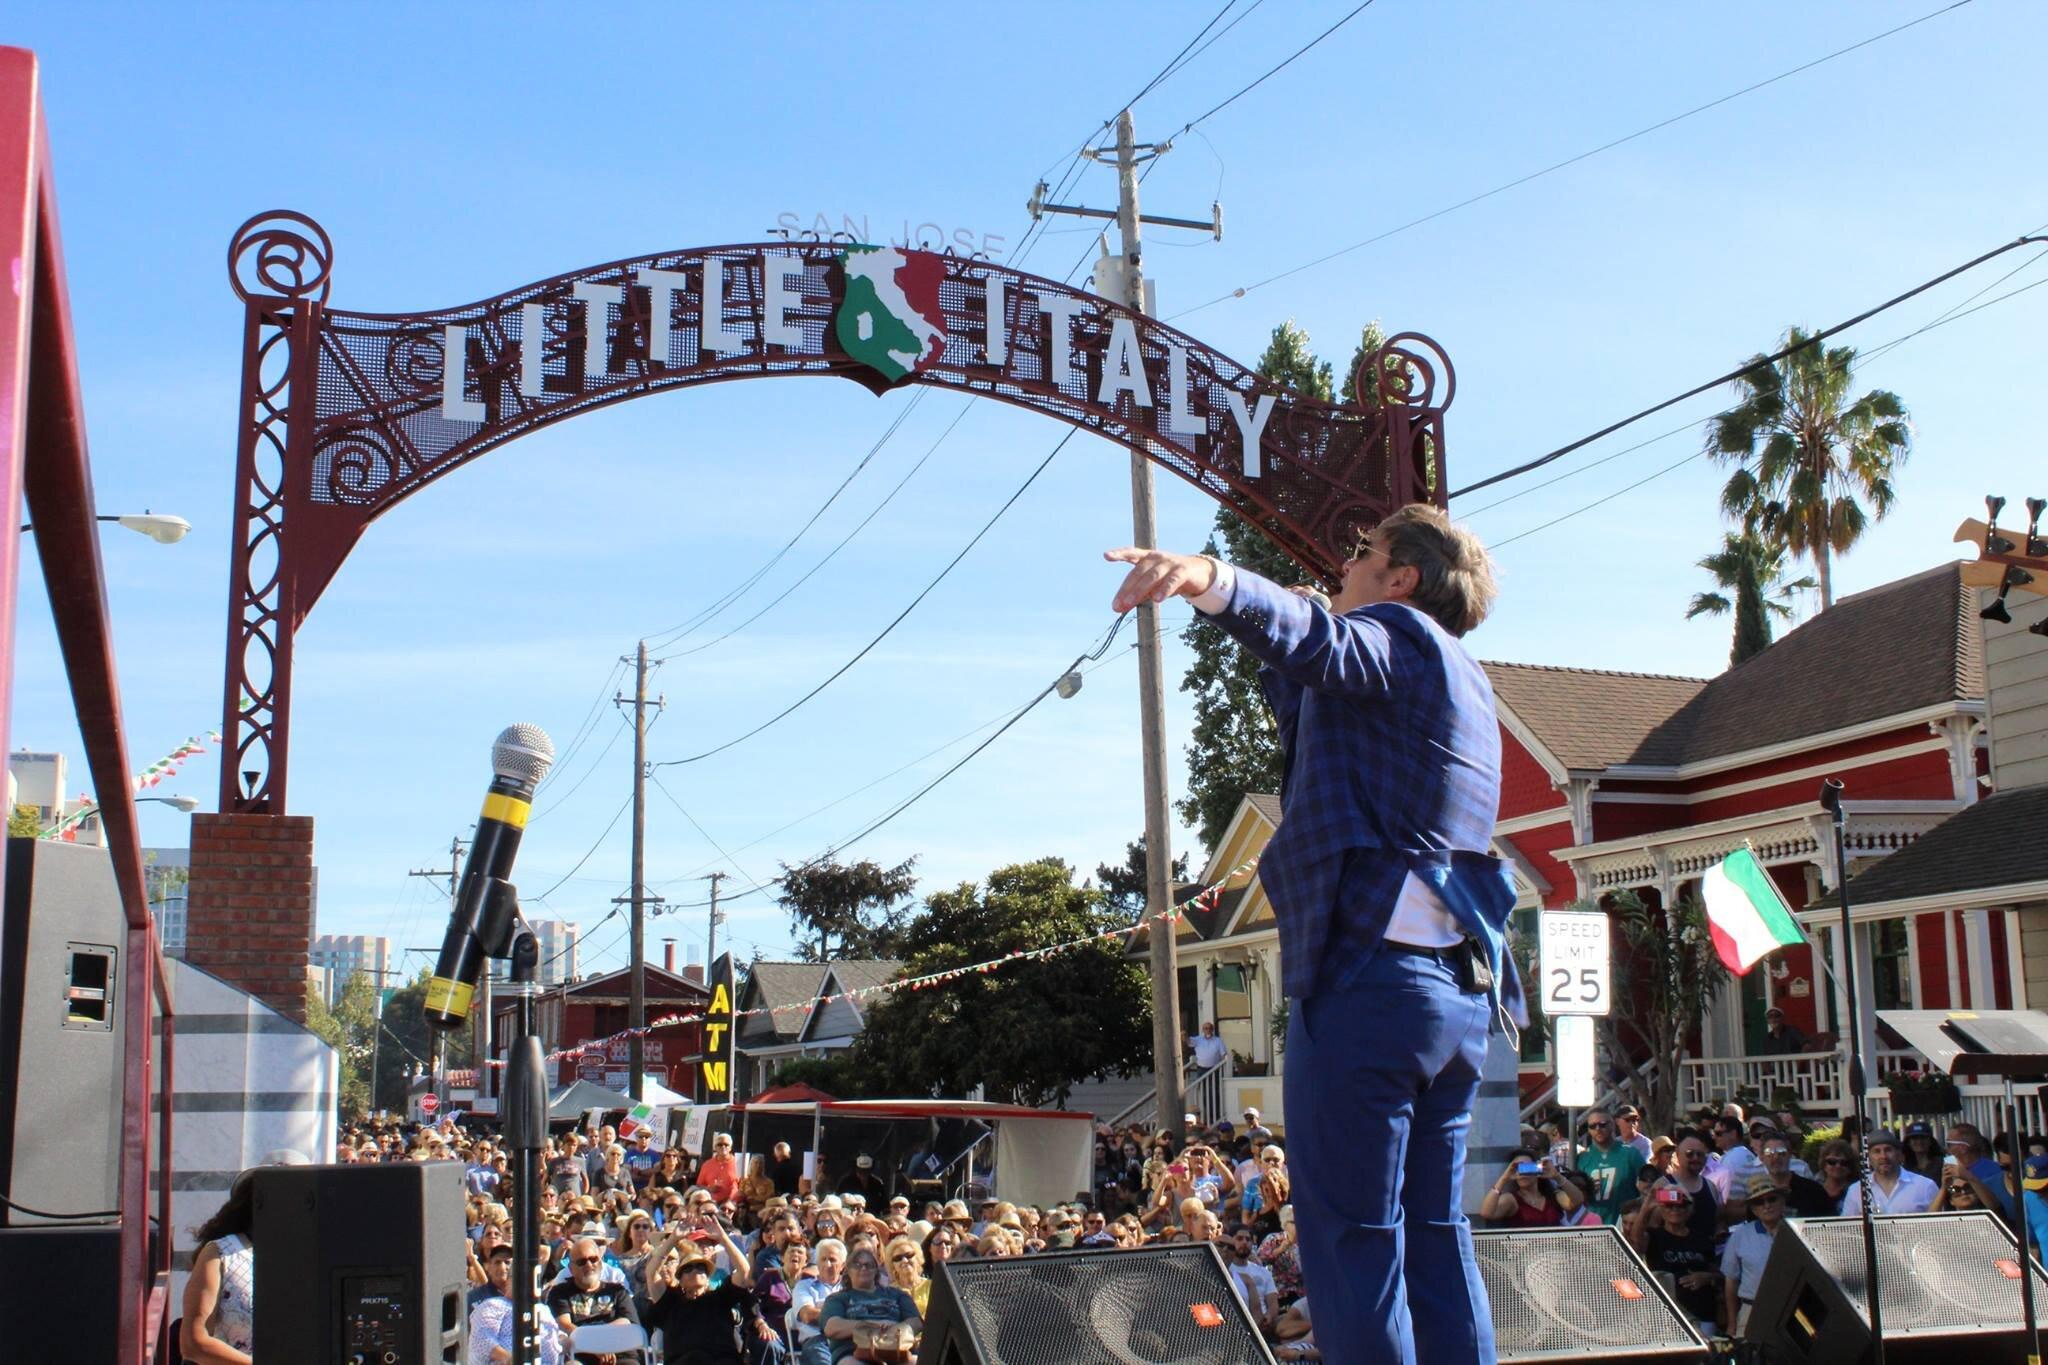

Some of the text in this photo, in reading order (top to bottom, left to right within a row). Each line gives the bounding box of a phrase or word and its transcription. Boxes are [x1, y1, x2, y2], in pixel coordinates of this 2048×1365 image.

[777, 212, 1005, 255] SAN JOSE
[442, 255, 1276, 478] LITTLE ITALY
[1549, 922, 1602, 938] SPEED
[1554, 946, 1596, 960] LIMIT
[1551, 968, 1600, 1002] 25
[703, 983, 730, 1092] ATM
[423, 1098, 438, 1106] STOP
